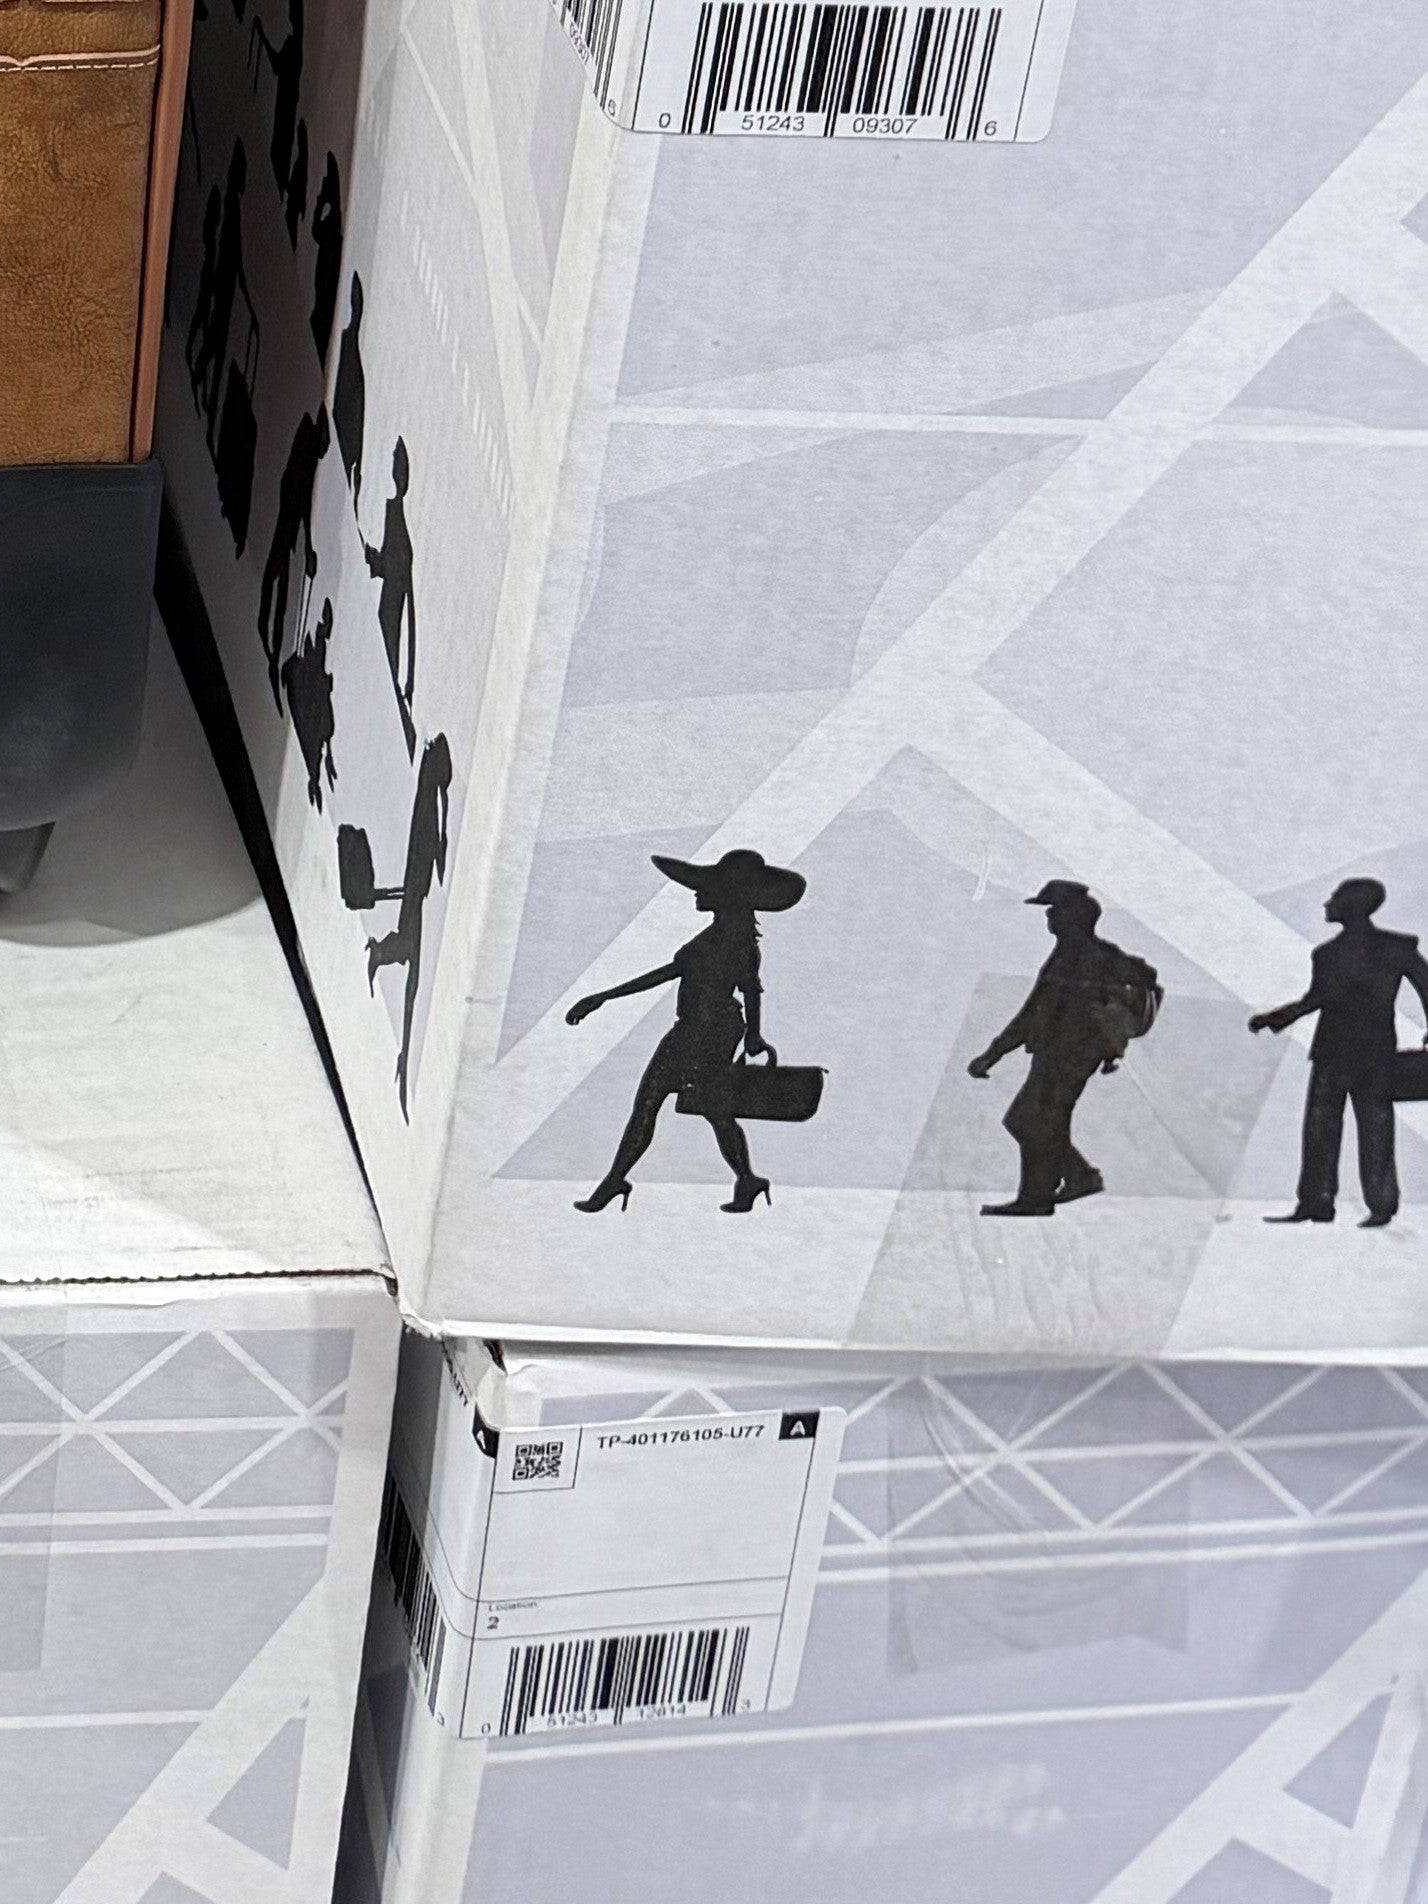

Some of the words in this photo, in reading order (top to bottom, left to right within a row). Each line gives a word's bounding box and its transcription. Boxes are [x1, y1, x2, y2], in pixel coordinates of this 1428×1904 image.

[657, 112, 672, 130] 0
[740, 114, 805, 132] 51243
[852, 117, 918, 135] 09307
[983, 119, 998, 136] 6
[596, 1423, 766, 1450] TP-401176105-U77
[790, 1419, 808, 1438] A
[485, 1616, 501, 1631] 2
[480, 1721, 492, 1737] 0
